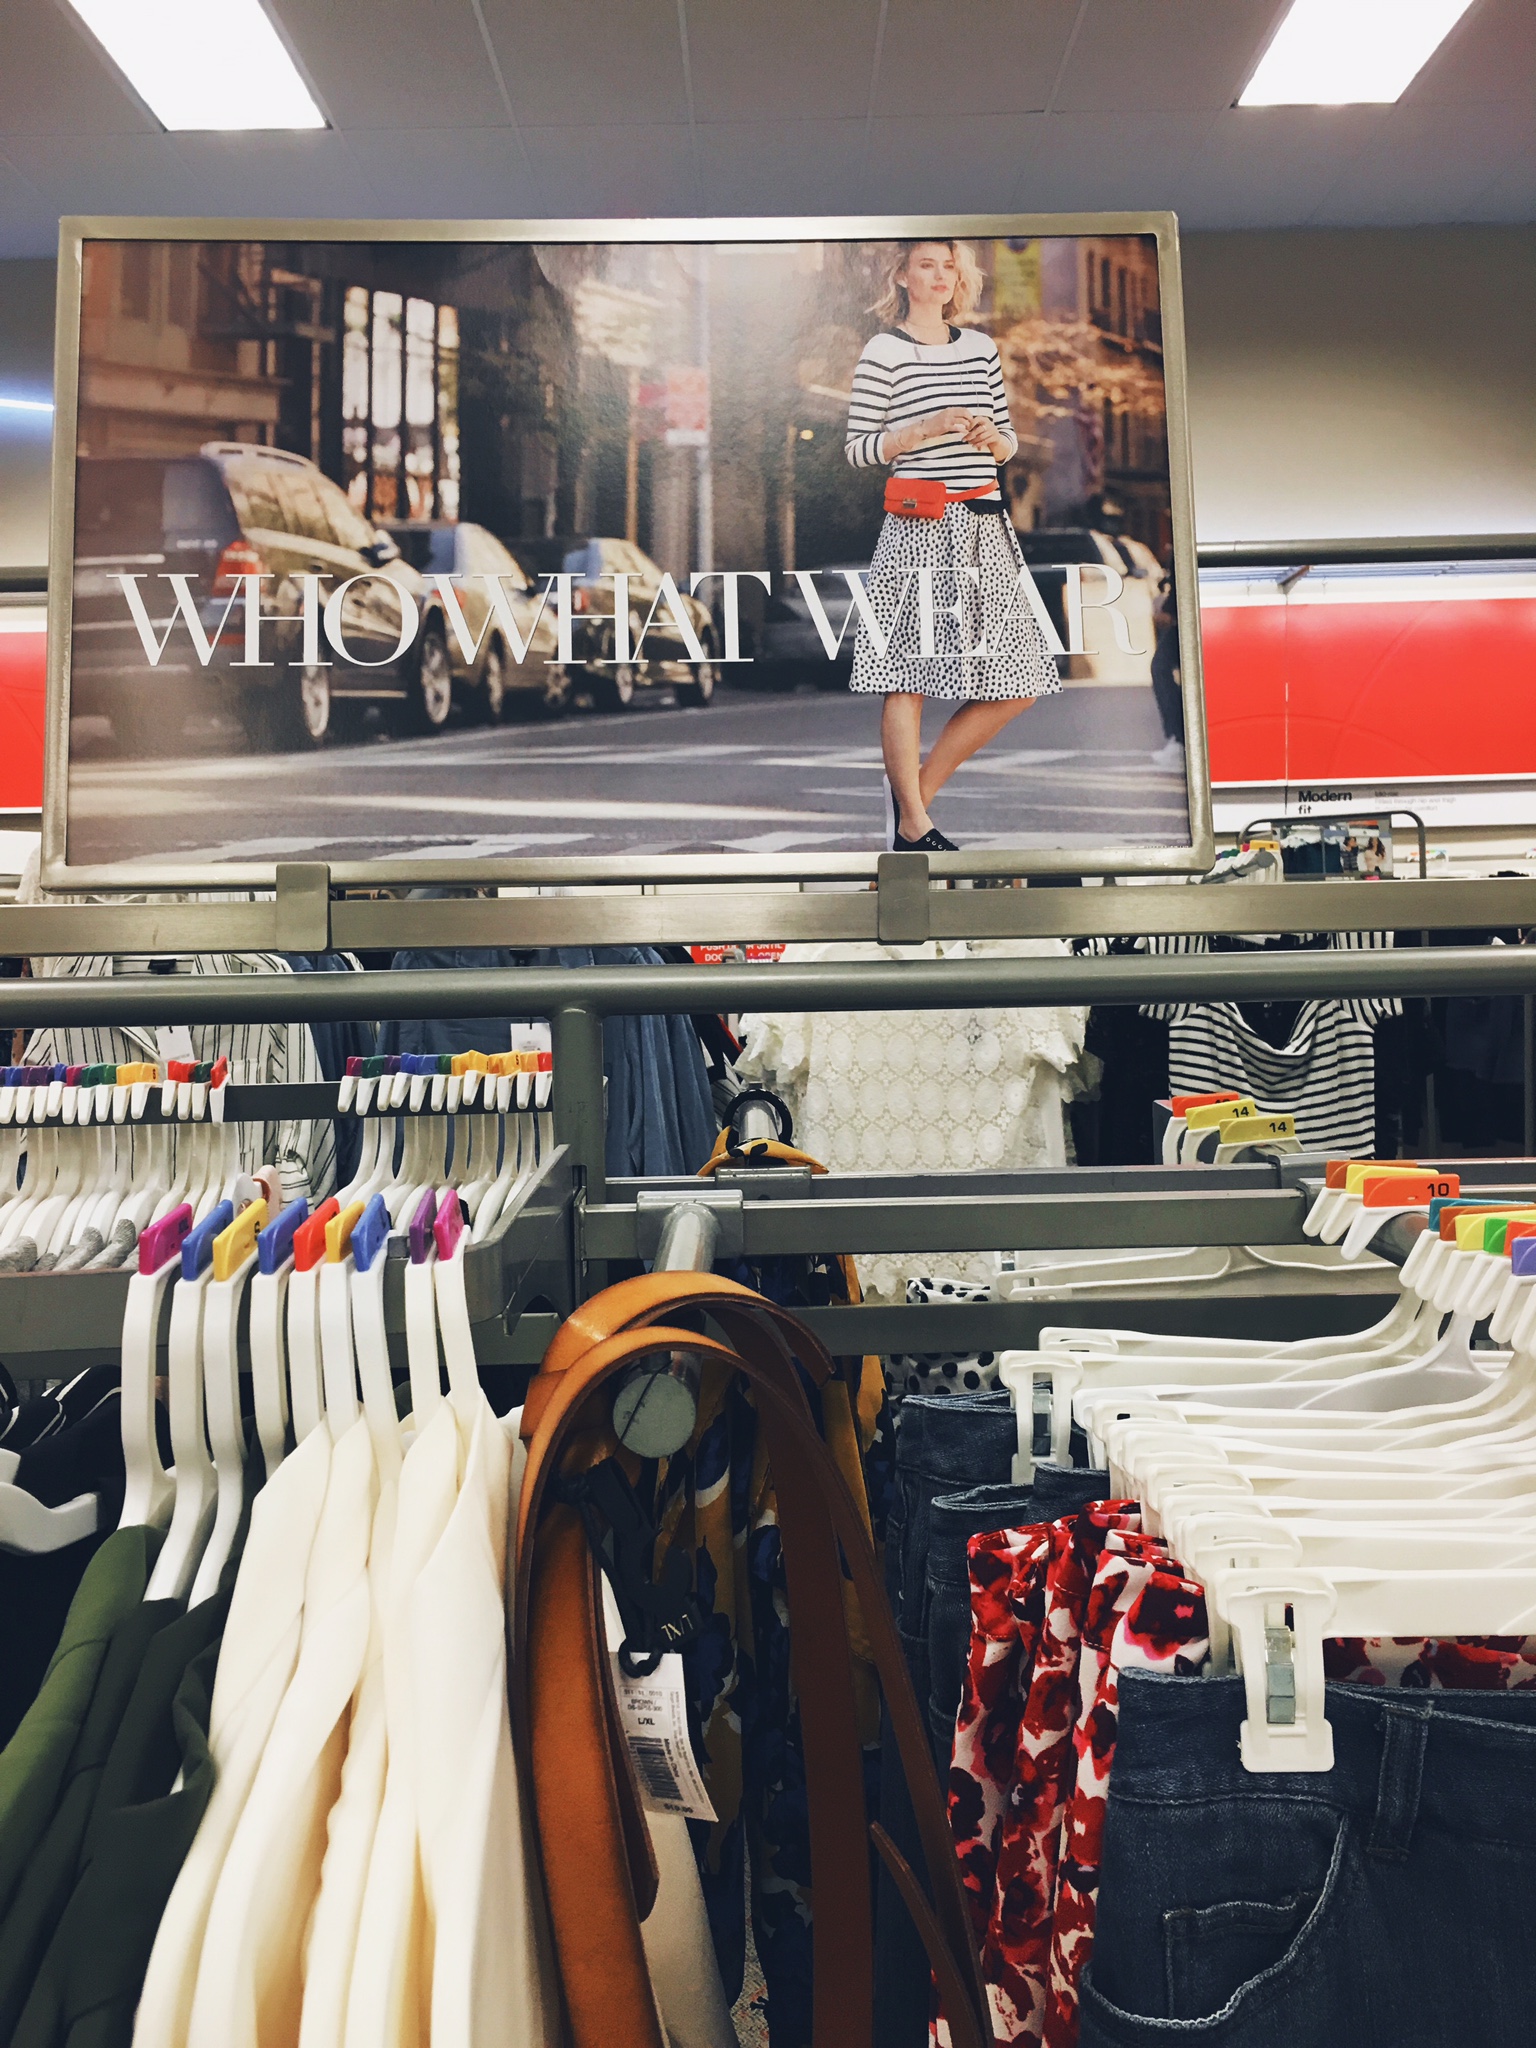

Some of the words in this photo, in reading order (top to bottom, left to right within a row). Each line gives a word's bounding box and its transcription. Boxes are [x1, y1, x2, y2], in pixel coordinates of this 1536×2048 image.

[106, 573, 420, 667] WHO
[422, 571, 772, 665] WHAT
[782, 563, 1148, 661] WEAR
[1298, 790, 1353, 803] Modern
[1298, 805, 1312, 814] fit
[1232, 1106, 1250, 1118] 14
[1269, 1121, 1287, 1133] 14
[1427, 1182, 1450, 1197] 10
